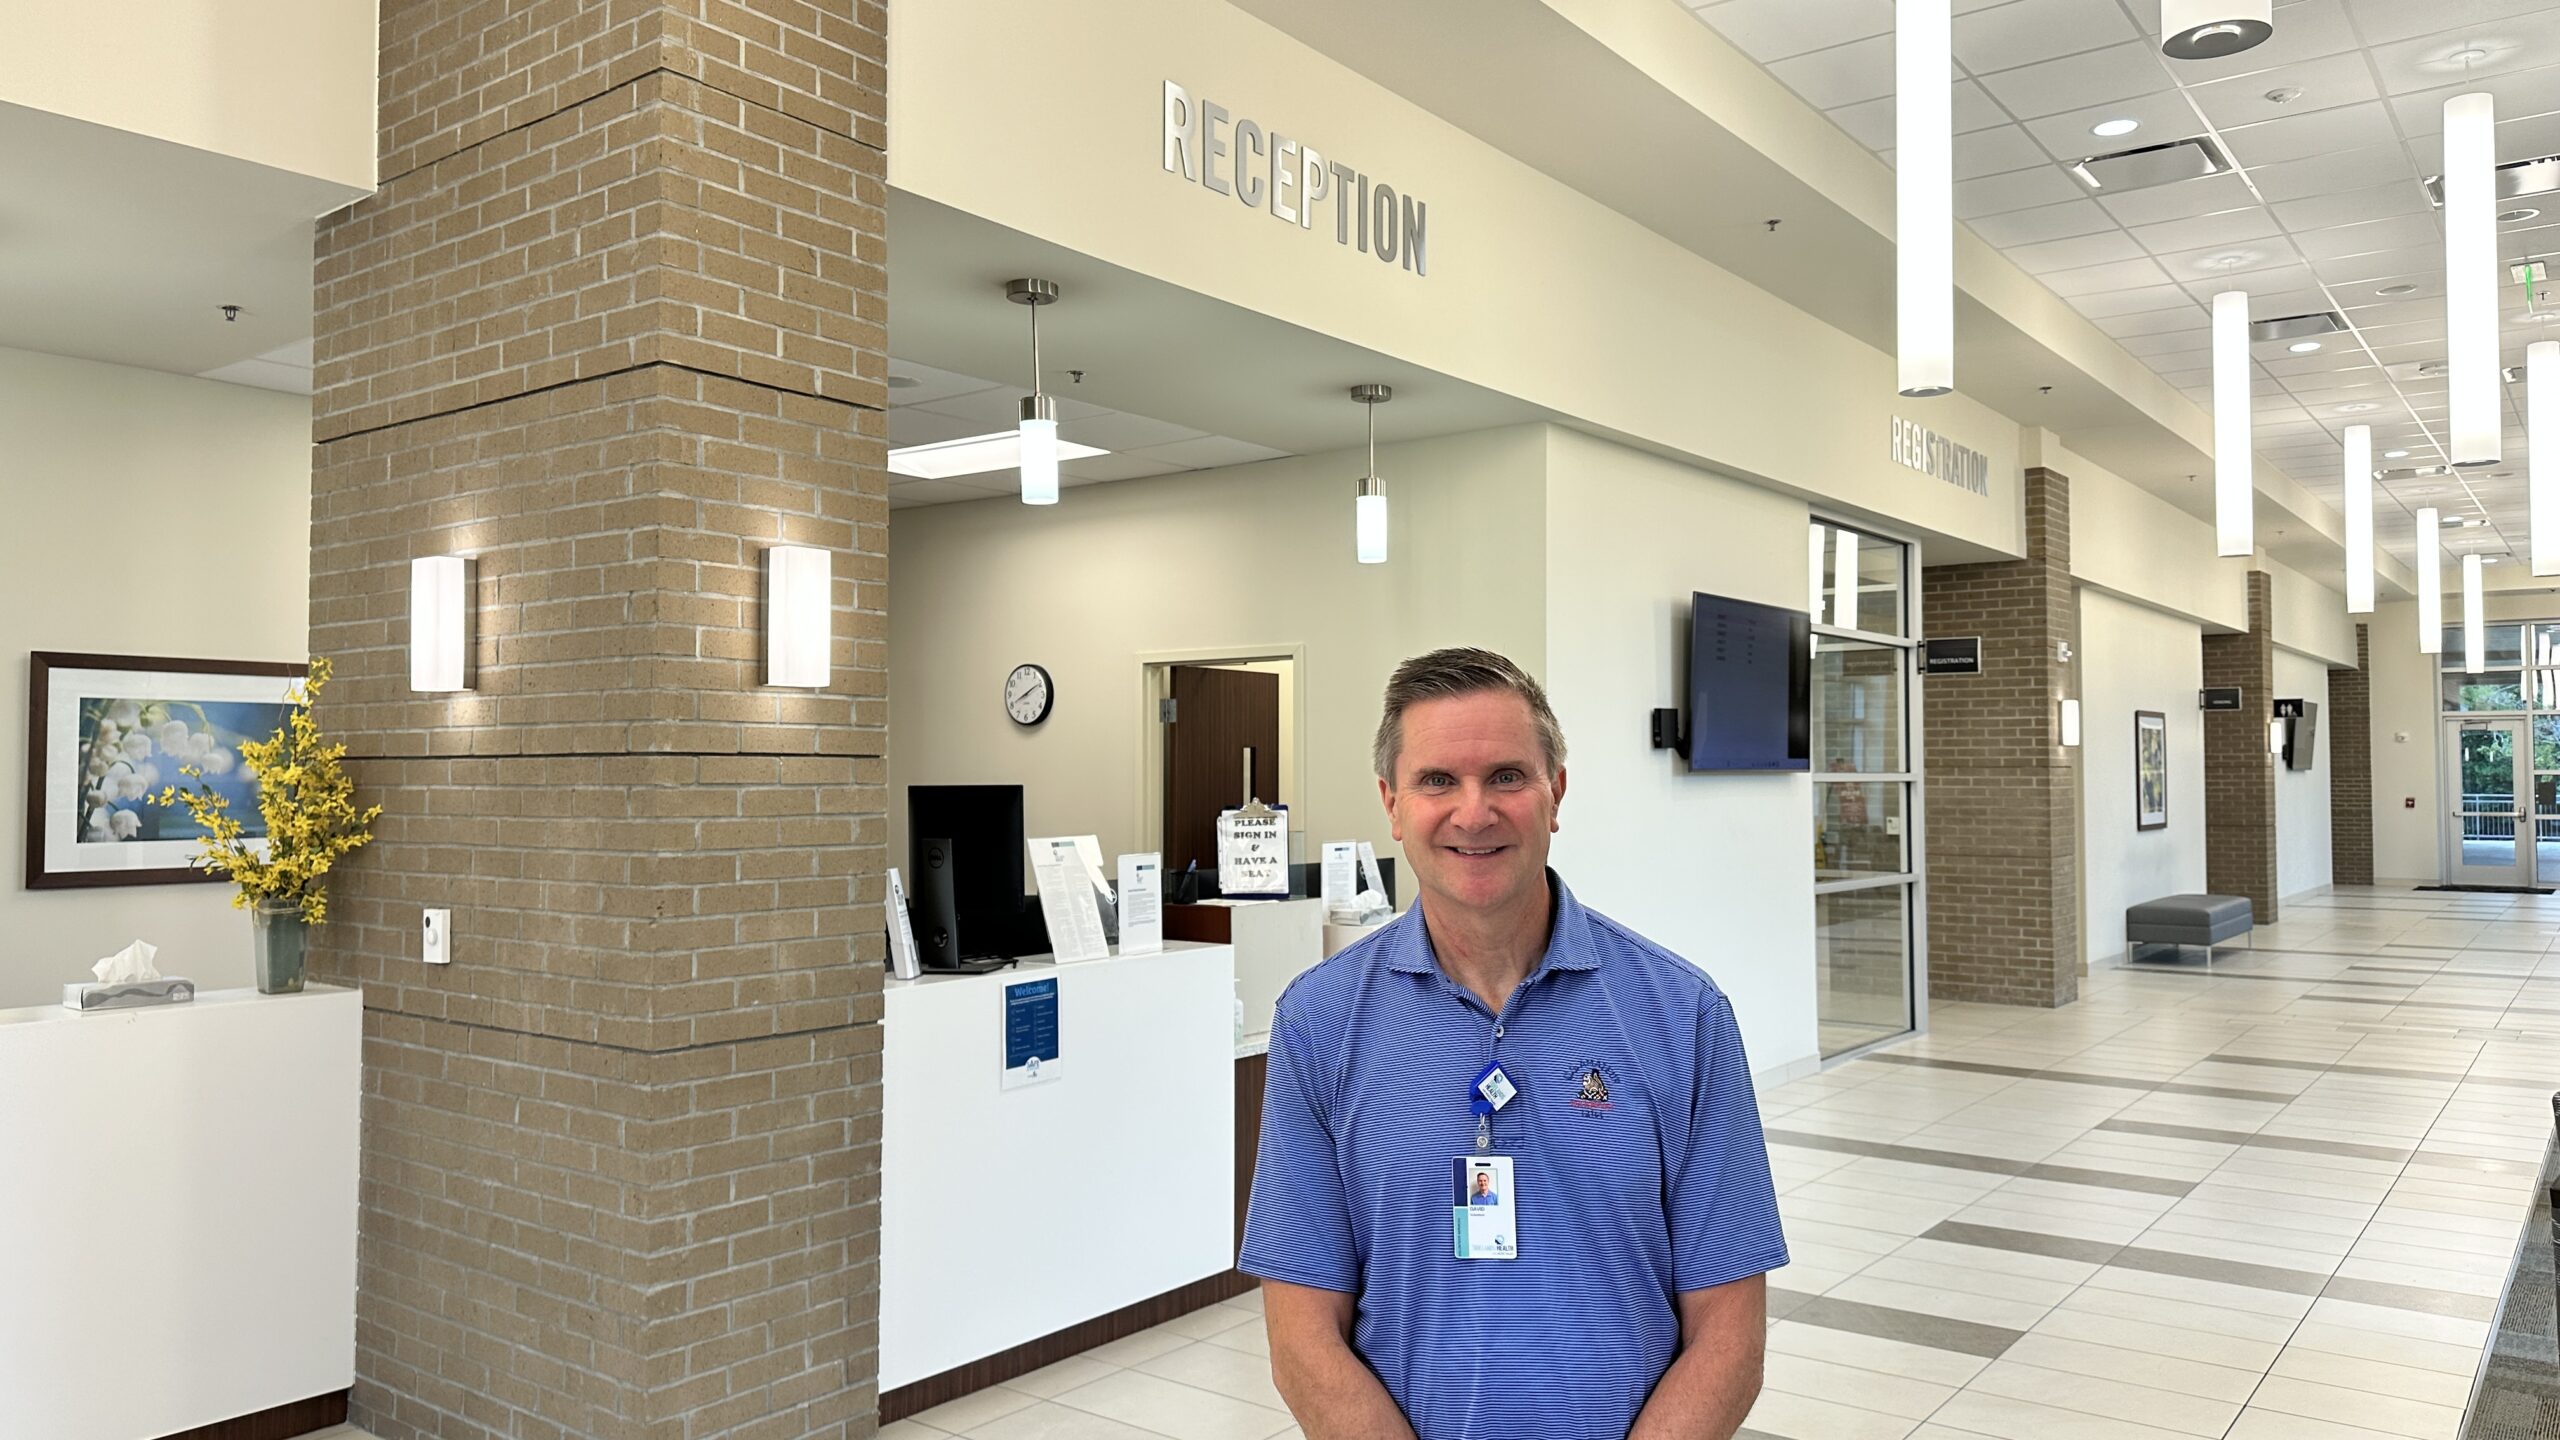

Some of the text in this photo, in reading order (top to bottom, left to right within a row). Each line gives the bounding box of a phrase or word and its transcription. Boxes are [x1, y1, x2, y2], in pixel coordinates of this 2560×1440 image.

[1163, 79, 1426, 276] RECEPTION
[1891, 414, 1988, 497] REGISTRATION
[1929, 657, 1974, 665] REGISTRATION
[1017, 672, 1022, 680] 11
[1024, 668, 1031, 676] 12
[1010, 680, 1016, 688] 10
[1008, 690, 1012, 699] 9
[1041, 691, 1045, 699] 3
[1024, 713, 1028, 721] 6
[1032, 711, 1036, 719] 5
[1233, 831, 1277, 839] SIGN IN
[1251, 844, 1260, 852] &
[1234, 856, 1278, 865] HAVE A
[1014, 983, 1050, 997] Welcome!
